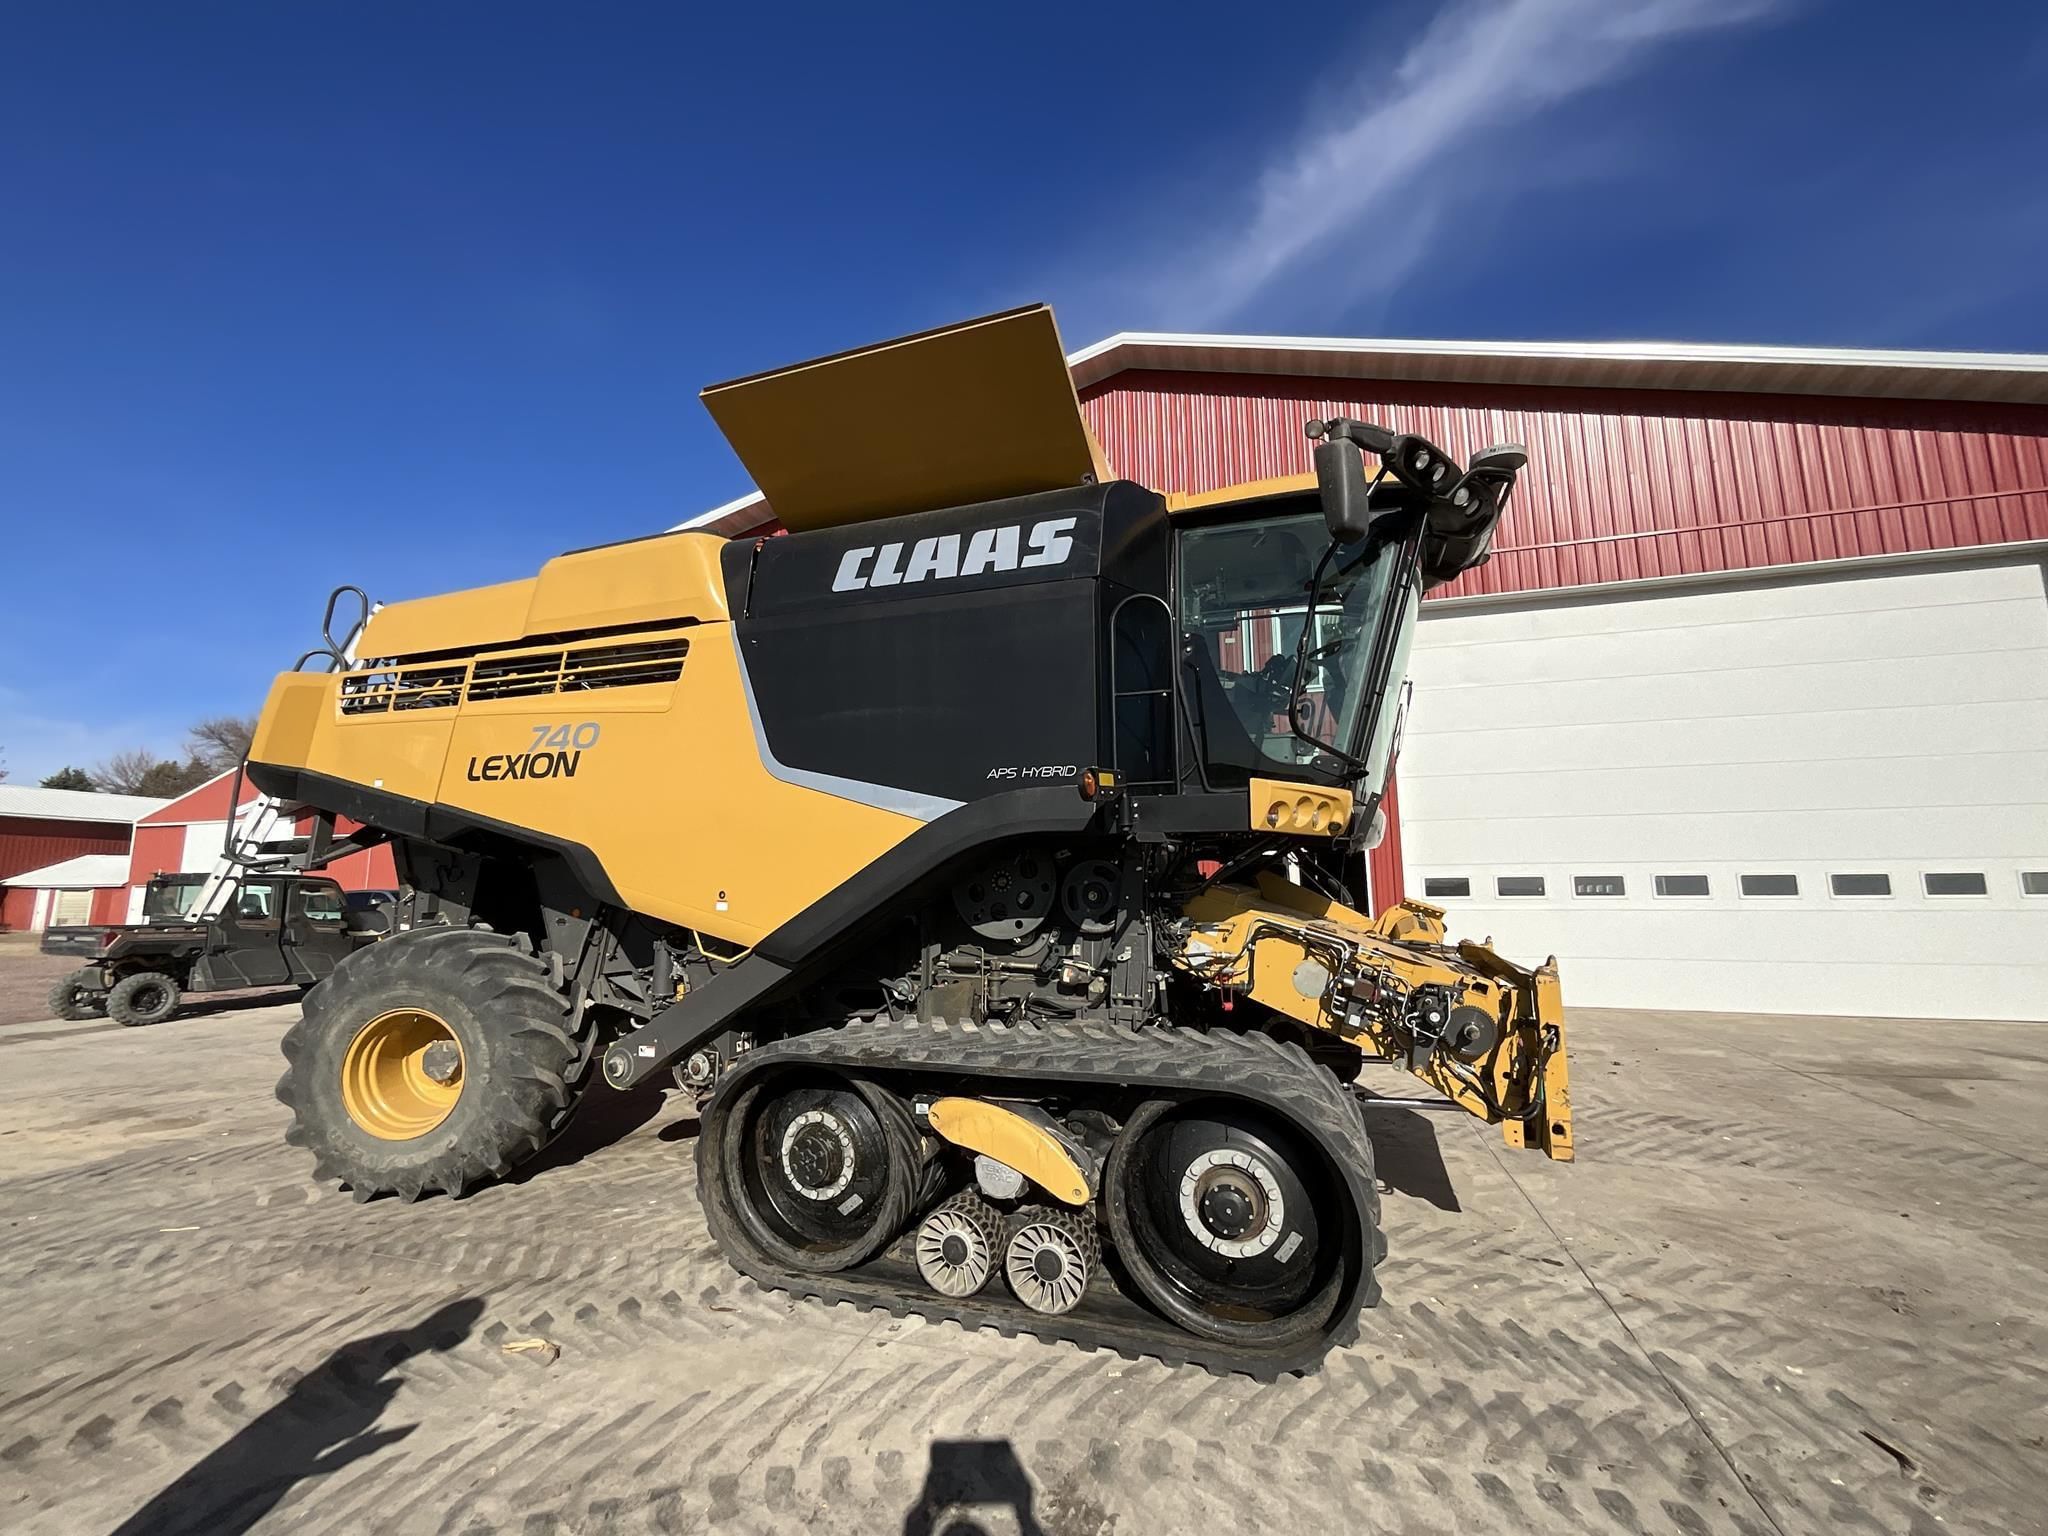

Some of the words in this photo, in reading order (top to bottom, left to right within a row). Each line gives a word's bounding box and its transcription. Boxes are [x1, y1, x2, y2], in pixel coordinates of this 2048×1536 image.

[831, 517, 1077, 592] CLAAS
[528, 721, 601, 752] 740
[467, 751, 581, 782] LEXION
[987, 767, 1017, 779] APS
[1021, 765, 1077, 778] HYBRID
